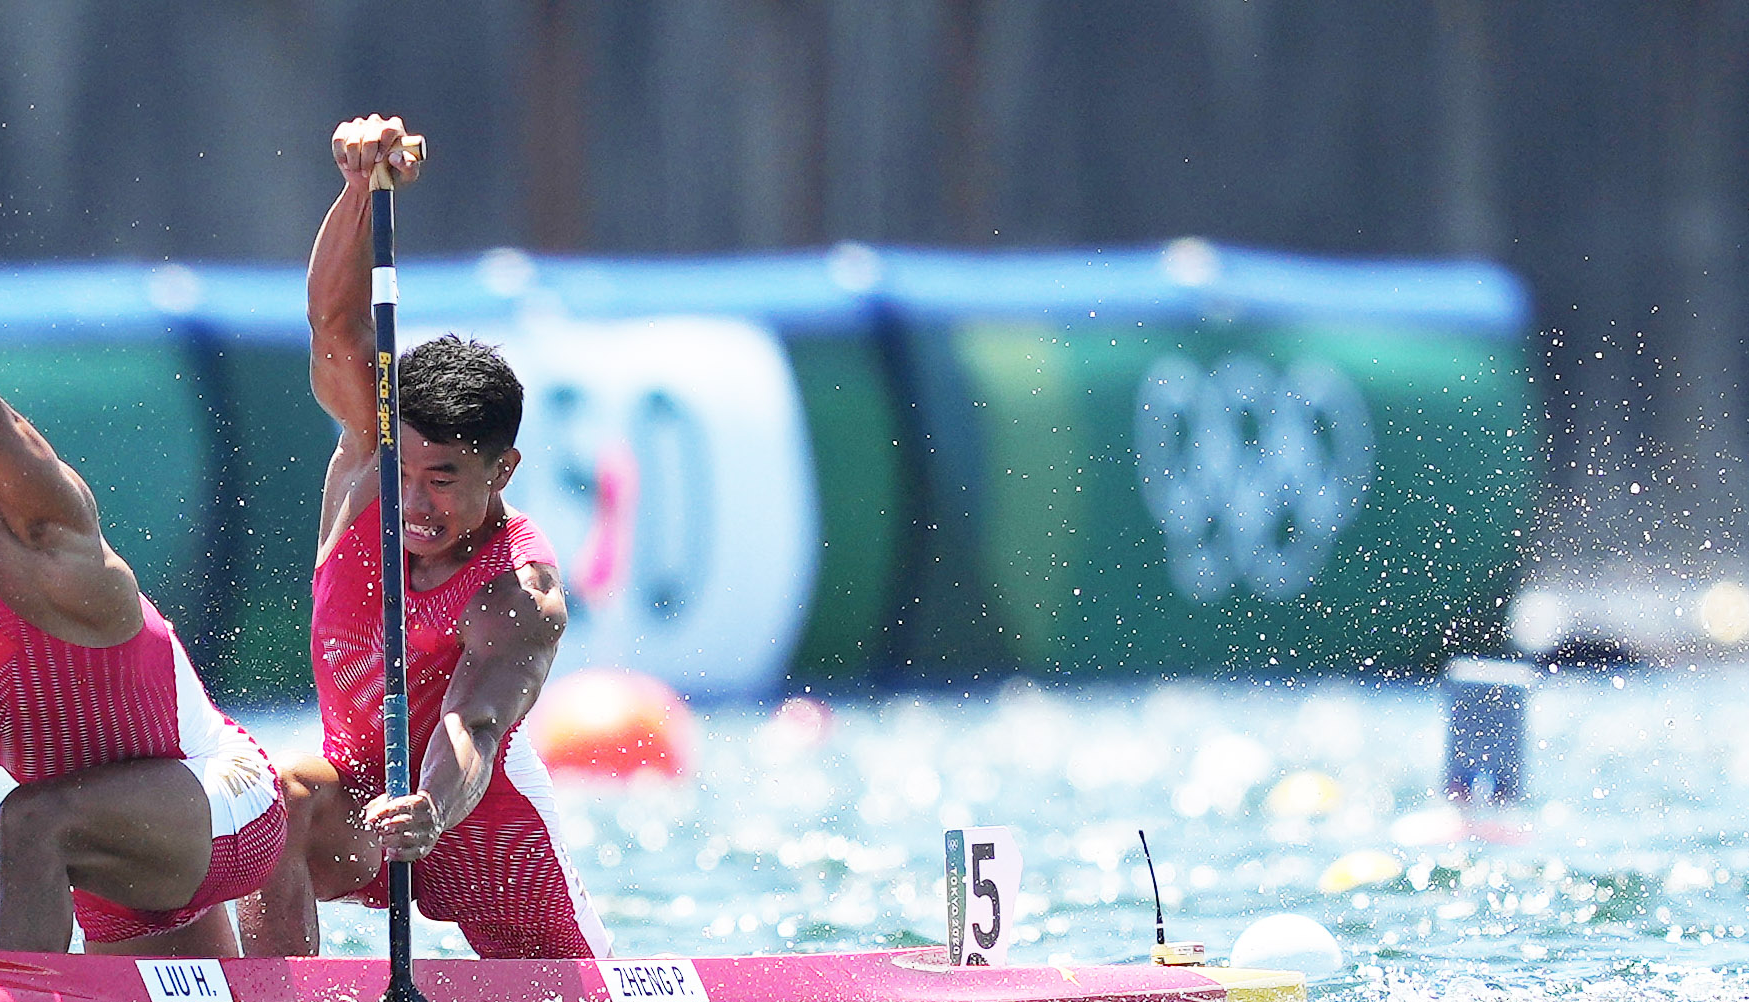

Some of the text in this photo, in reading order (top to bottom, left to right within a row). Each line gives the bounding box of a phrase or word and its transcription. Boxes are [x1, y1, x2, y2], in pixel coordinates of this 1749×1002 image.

[950, 866, 959, 916] TOKYO
[972, 843, 1001, 949] 5
[154, 965, 190, 996] LIU
[613, 966, 674, 996] ZHENG
